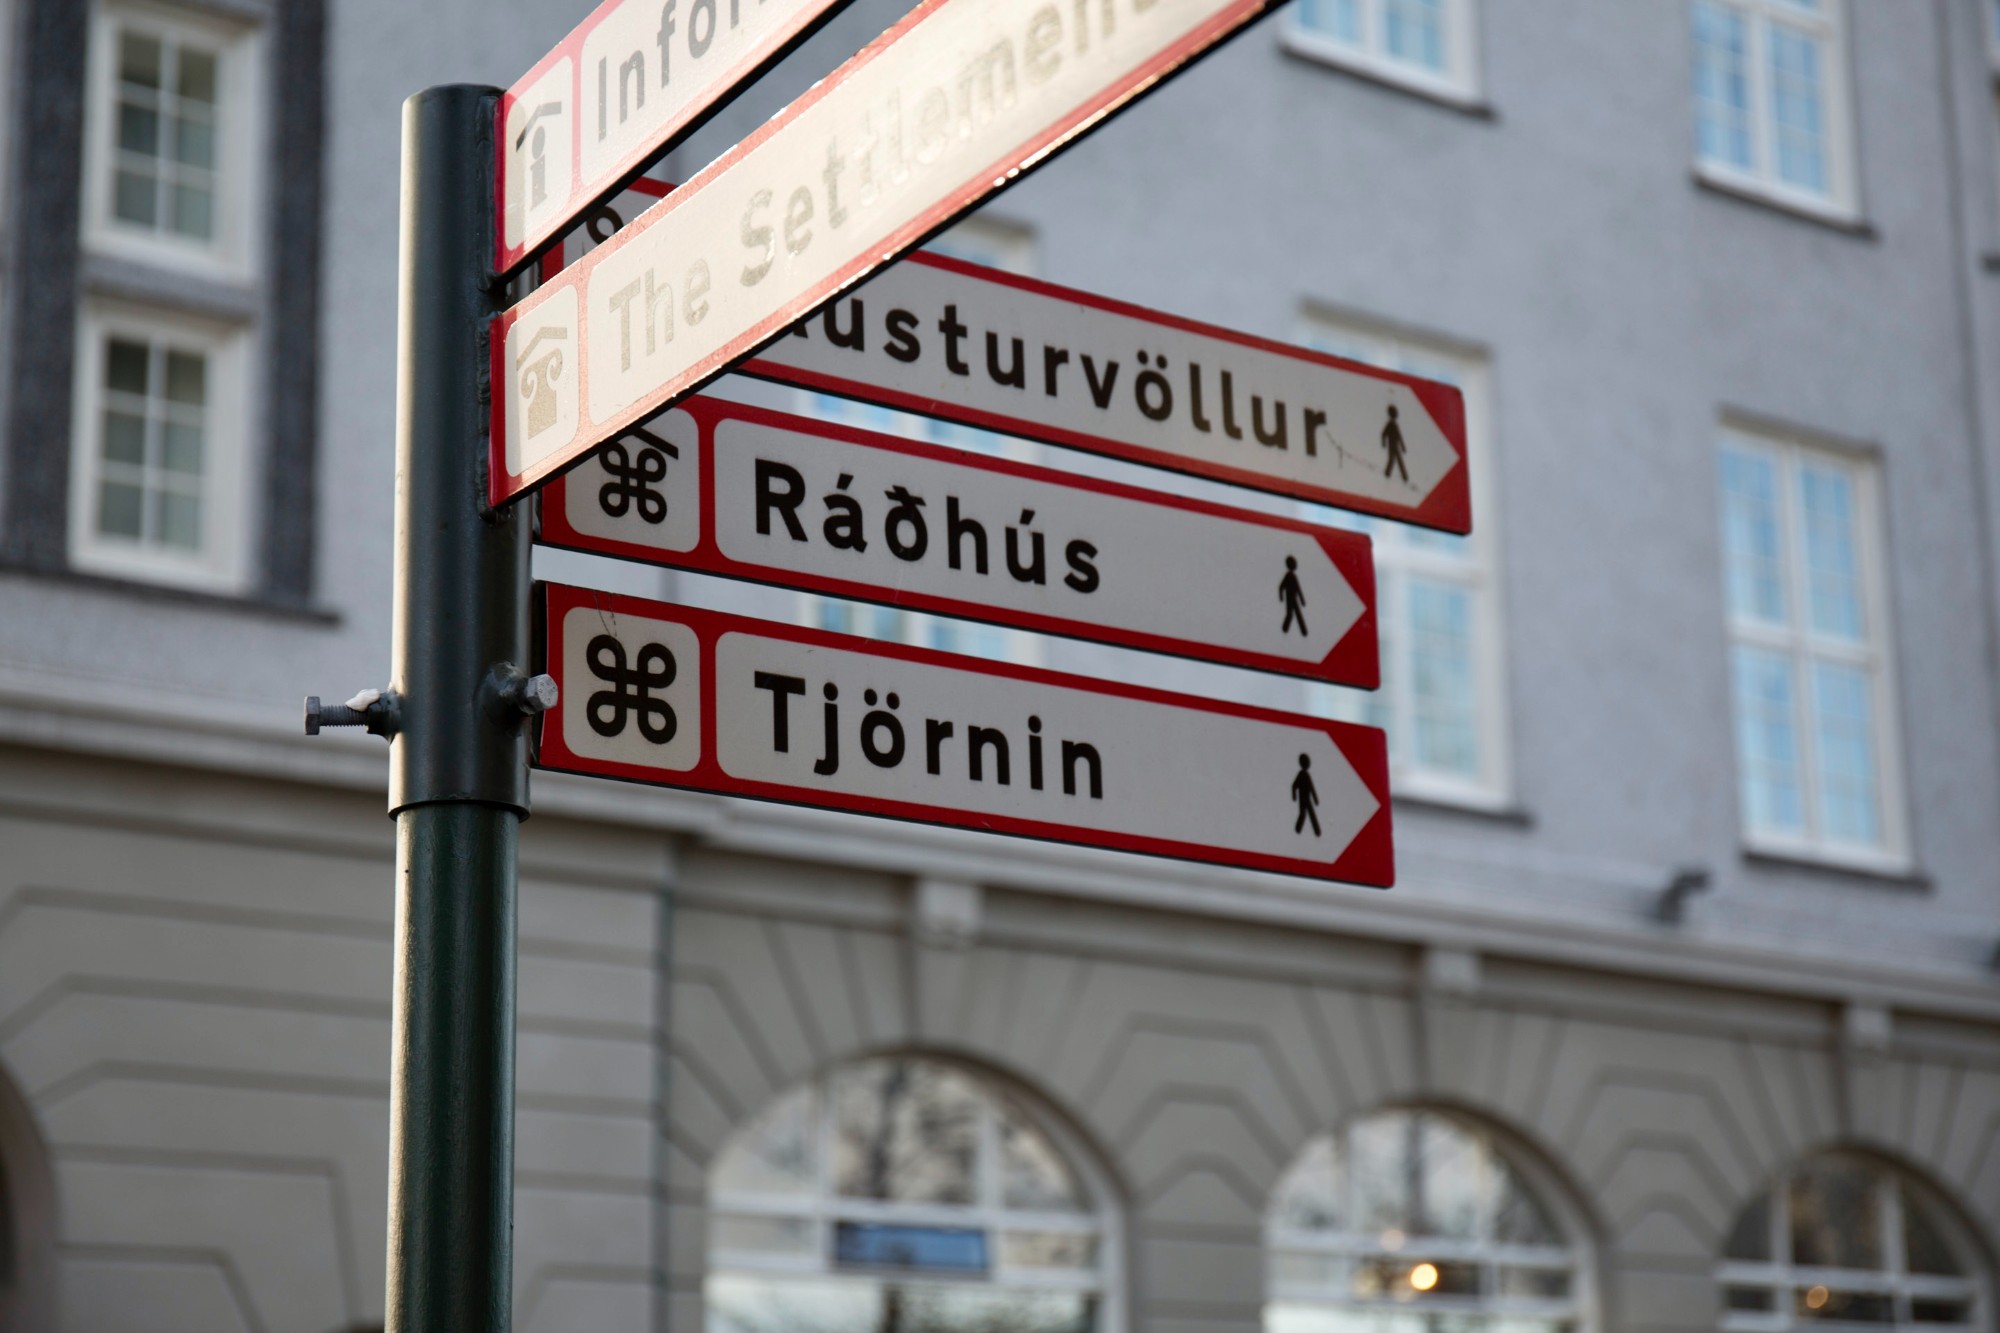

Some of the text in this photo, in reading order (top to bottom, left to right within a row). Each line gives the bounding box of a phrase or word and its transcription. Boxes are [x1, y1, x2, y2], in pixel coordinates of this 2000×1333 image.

[609, 0, 1157, 373] The Settlemen
[793, 298, 1326, 457] usturvöllur
[754, 458, 1100, 594] Ráðhús
[754, 671, 1103, 800] Tjörnin
